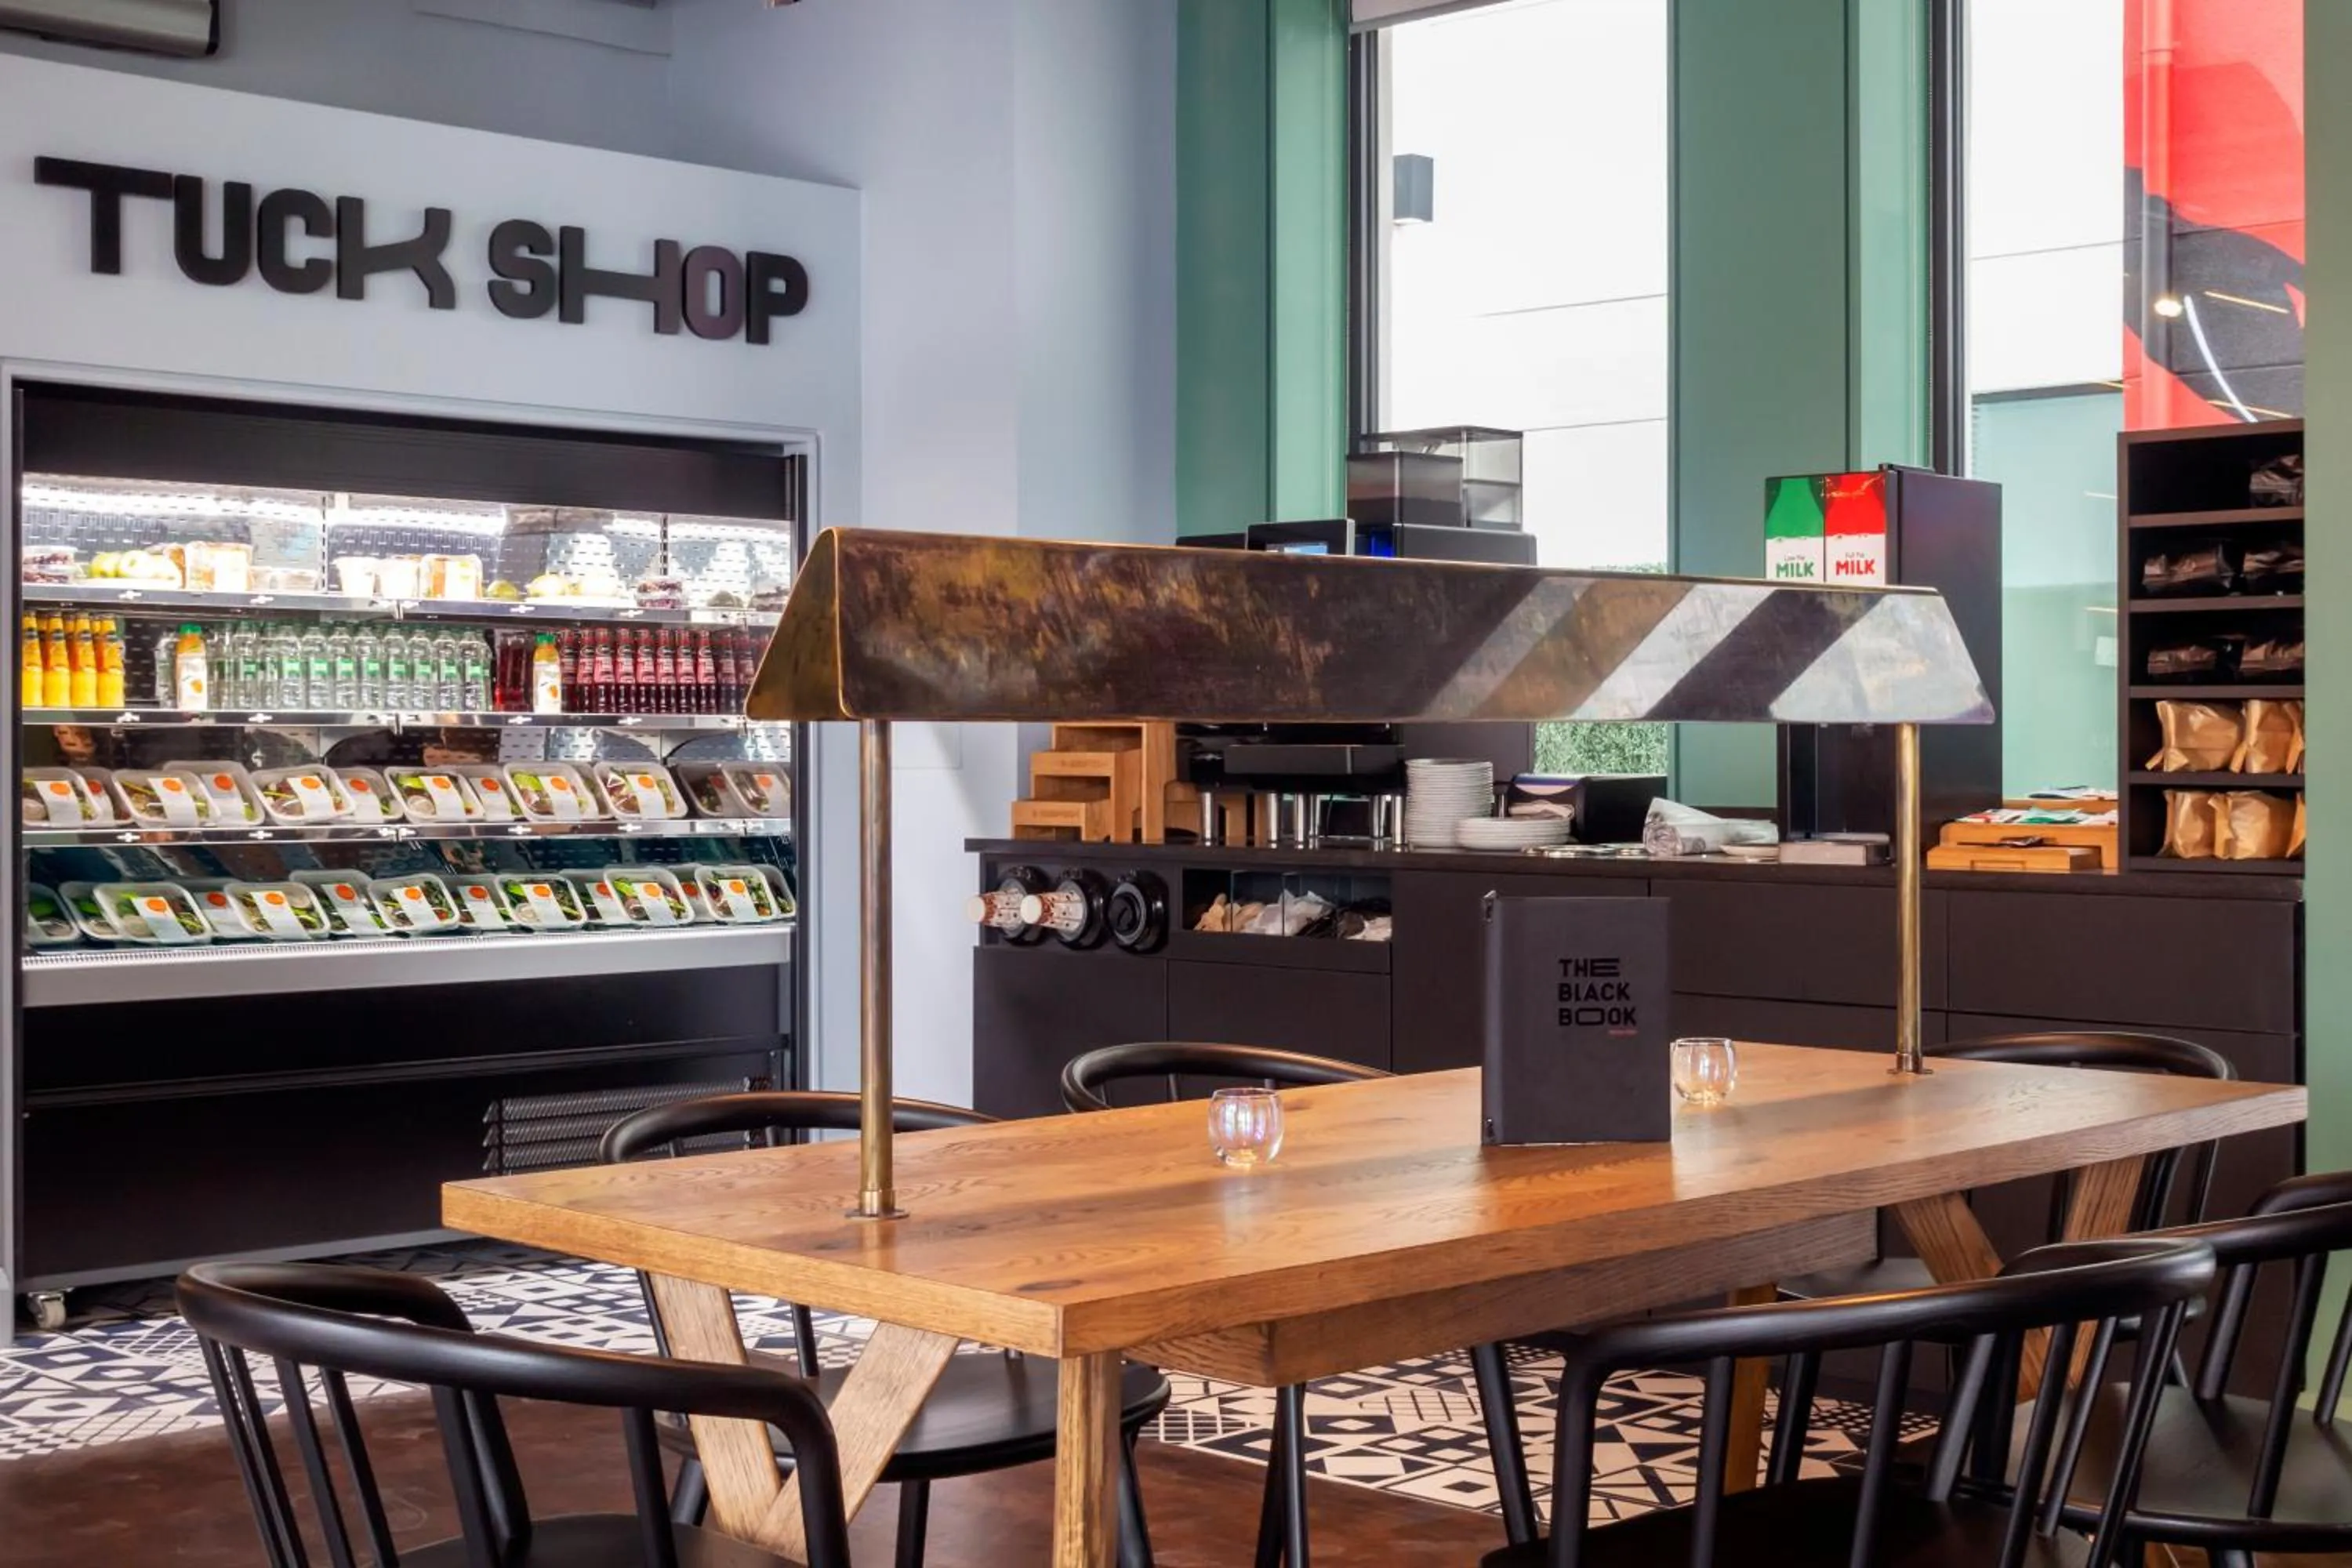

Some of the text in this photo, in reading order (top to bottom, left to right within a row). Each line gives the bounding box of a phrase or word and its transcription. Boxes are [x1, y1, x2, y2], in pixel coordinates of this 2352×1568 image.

[34, 156, 808, 345] TUCK SHOP
[1776, 562, 1814, 578] MILK
[1835, 559, 1875, 575] MILK
[1559, 957, 1620, 977] THE
[1559, 982, 1630, 1002] BLACK
[1559, 1007, 1637, 1026] BOOK
